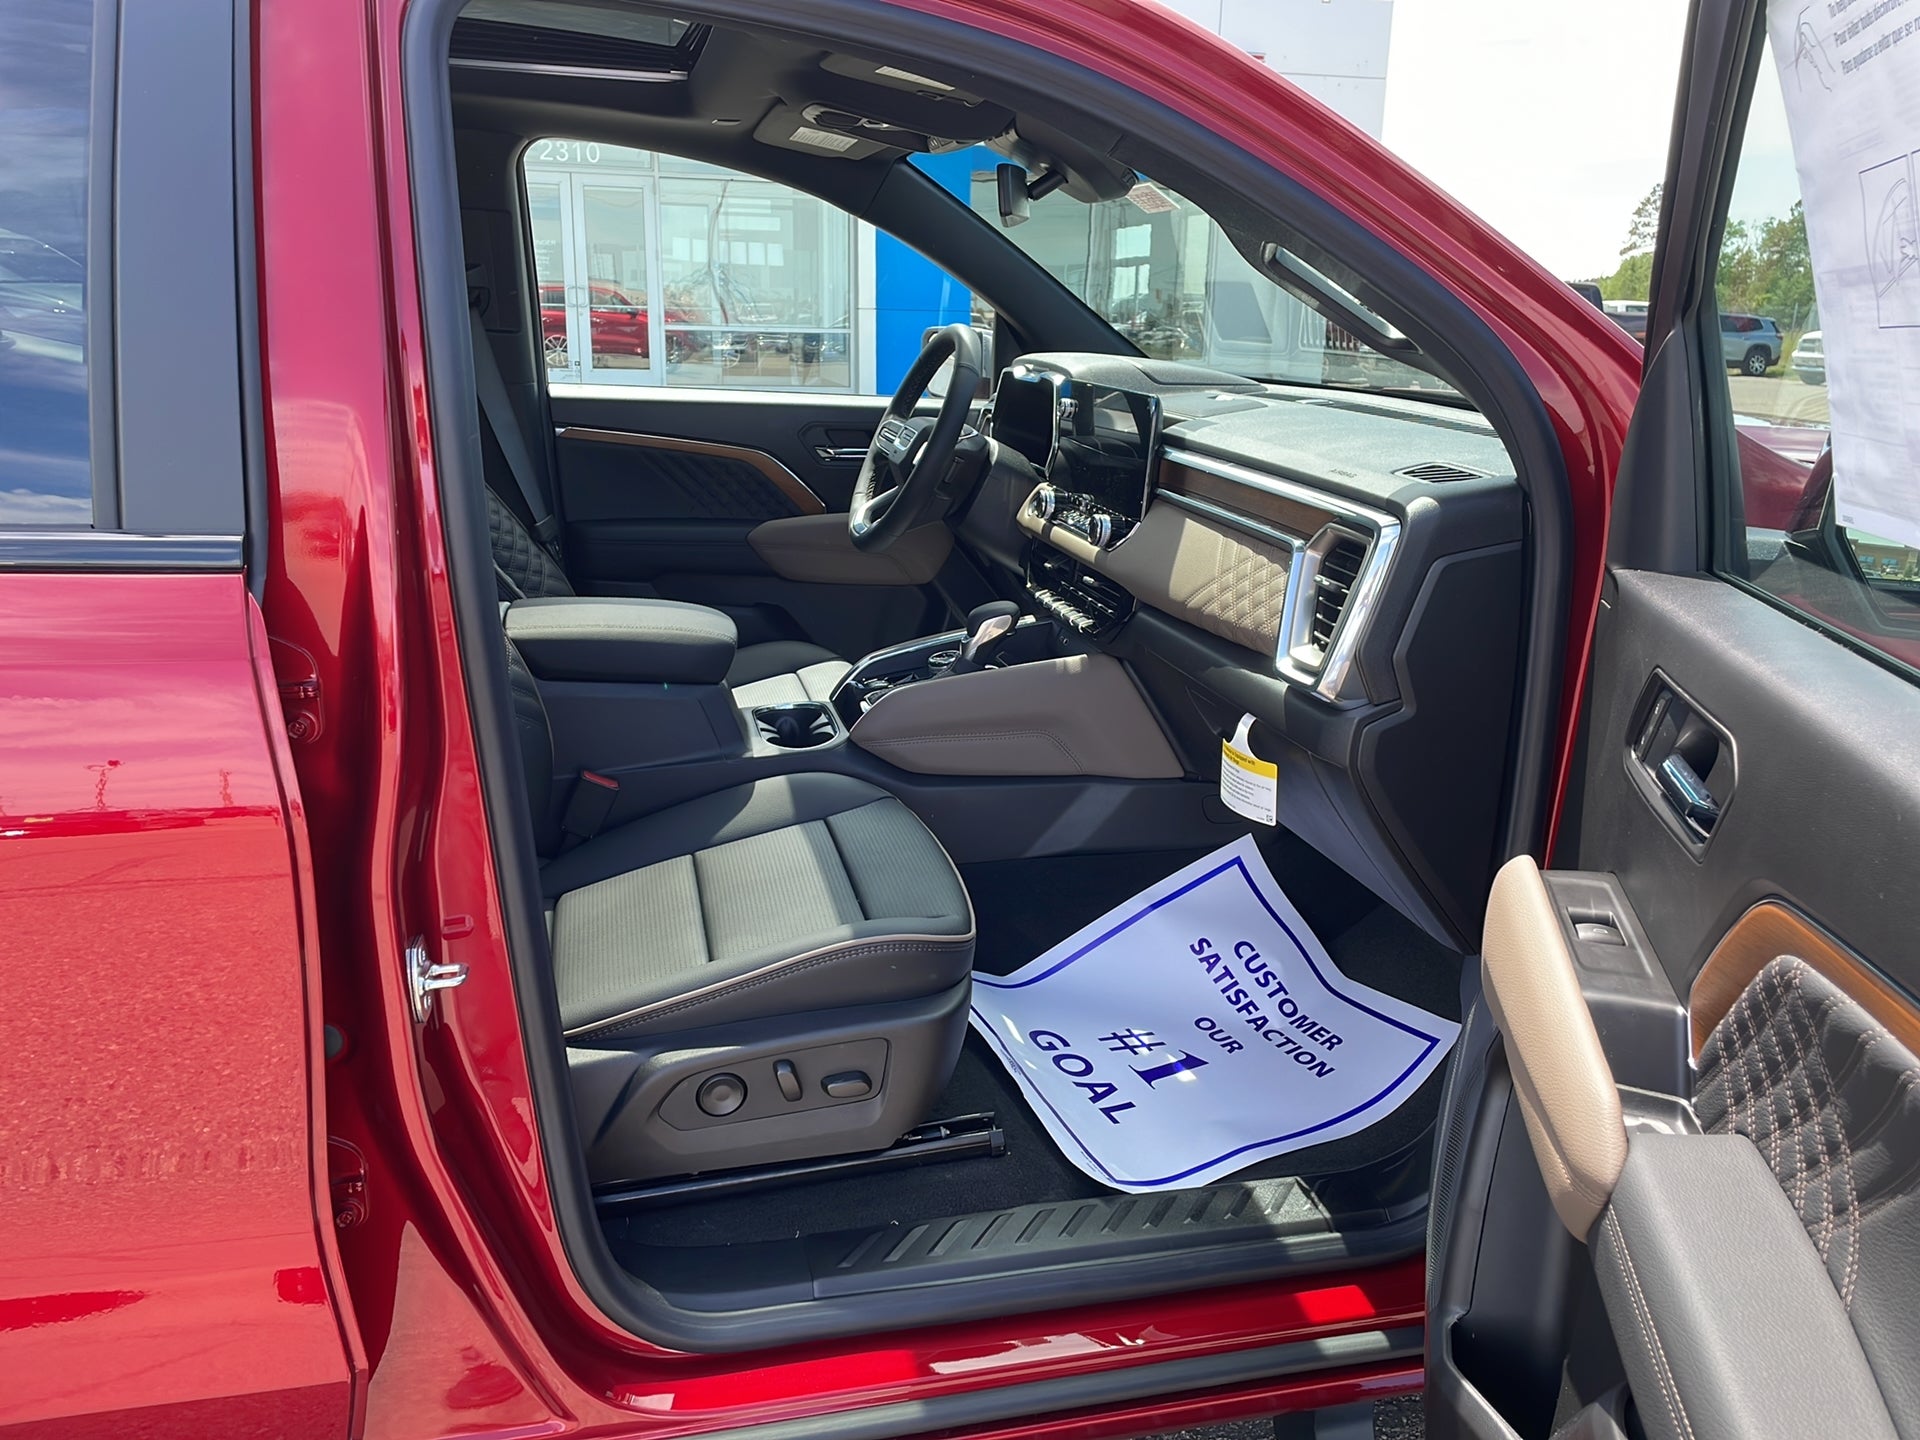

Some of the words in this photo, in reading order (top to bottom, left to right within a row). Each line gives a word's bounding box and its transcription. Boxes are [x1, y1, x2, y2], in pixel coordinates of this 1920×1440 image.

[1904, 21, 1914, 37] se
[539, 139, 600, 163] 2310
[1189, 937, 1336, 1079] SATISFACTION
[1233, 940, 1344, 1052] CUSTOMER
[1098, 1028, 1210, 1090] #1
[1194, 1016, 1245, 1055] OUR
[1028, 1029, 1137, 1125] GOAL
